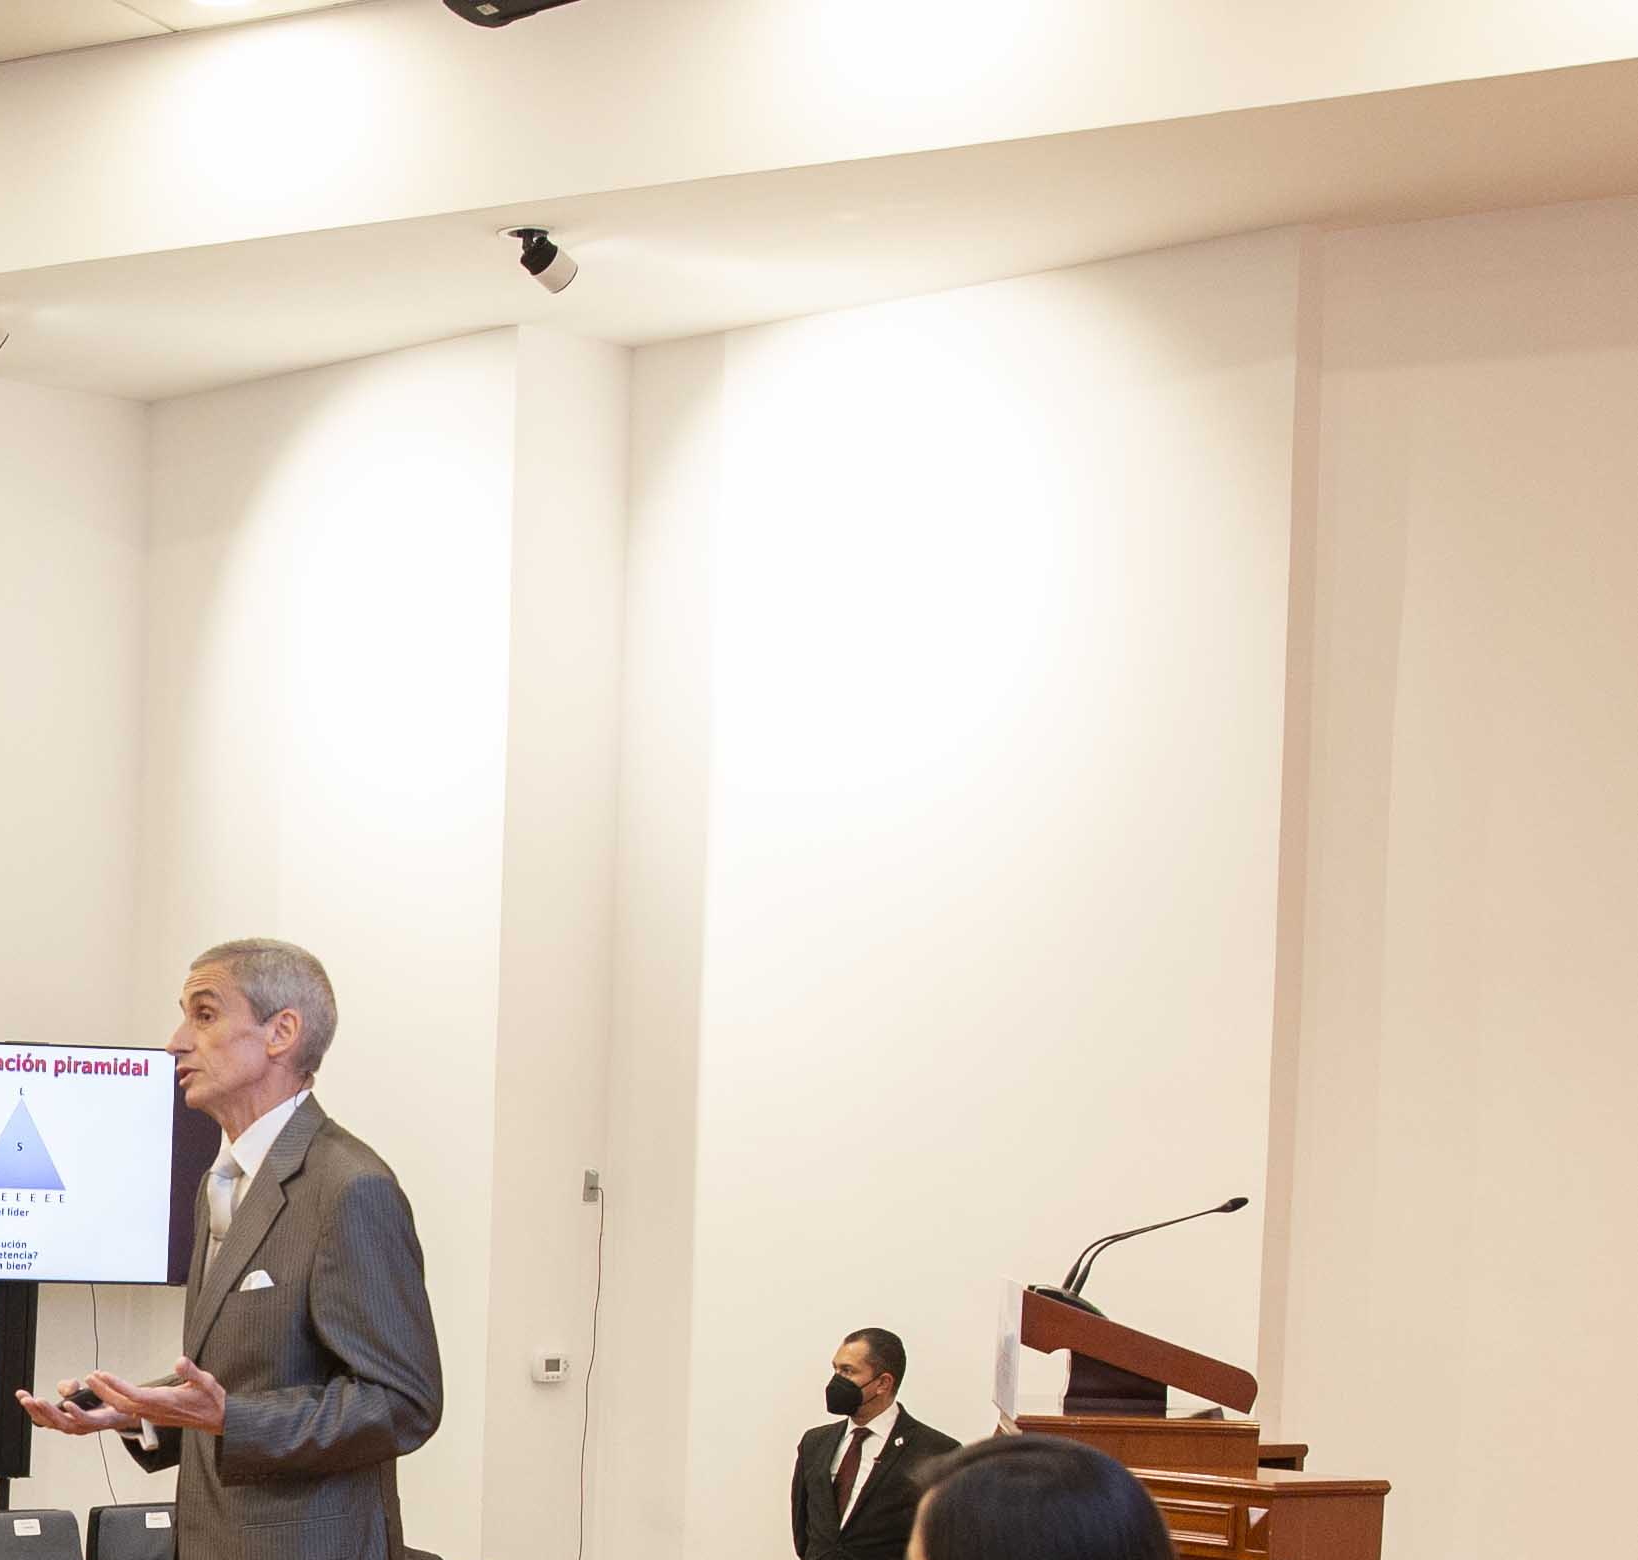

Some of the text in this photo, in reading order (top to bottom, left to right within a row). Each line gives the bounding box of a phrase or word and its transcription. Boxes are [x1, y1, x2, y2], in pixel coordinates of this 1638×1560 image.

[53, 1056, 149, 1077] piramidal
[15, 1142, 23, 1151] S
[7, 1208, 29, 1217] líder
[6, 1261, 32, 1271] bien?
